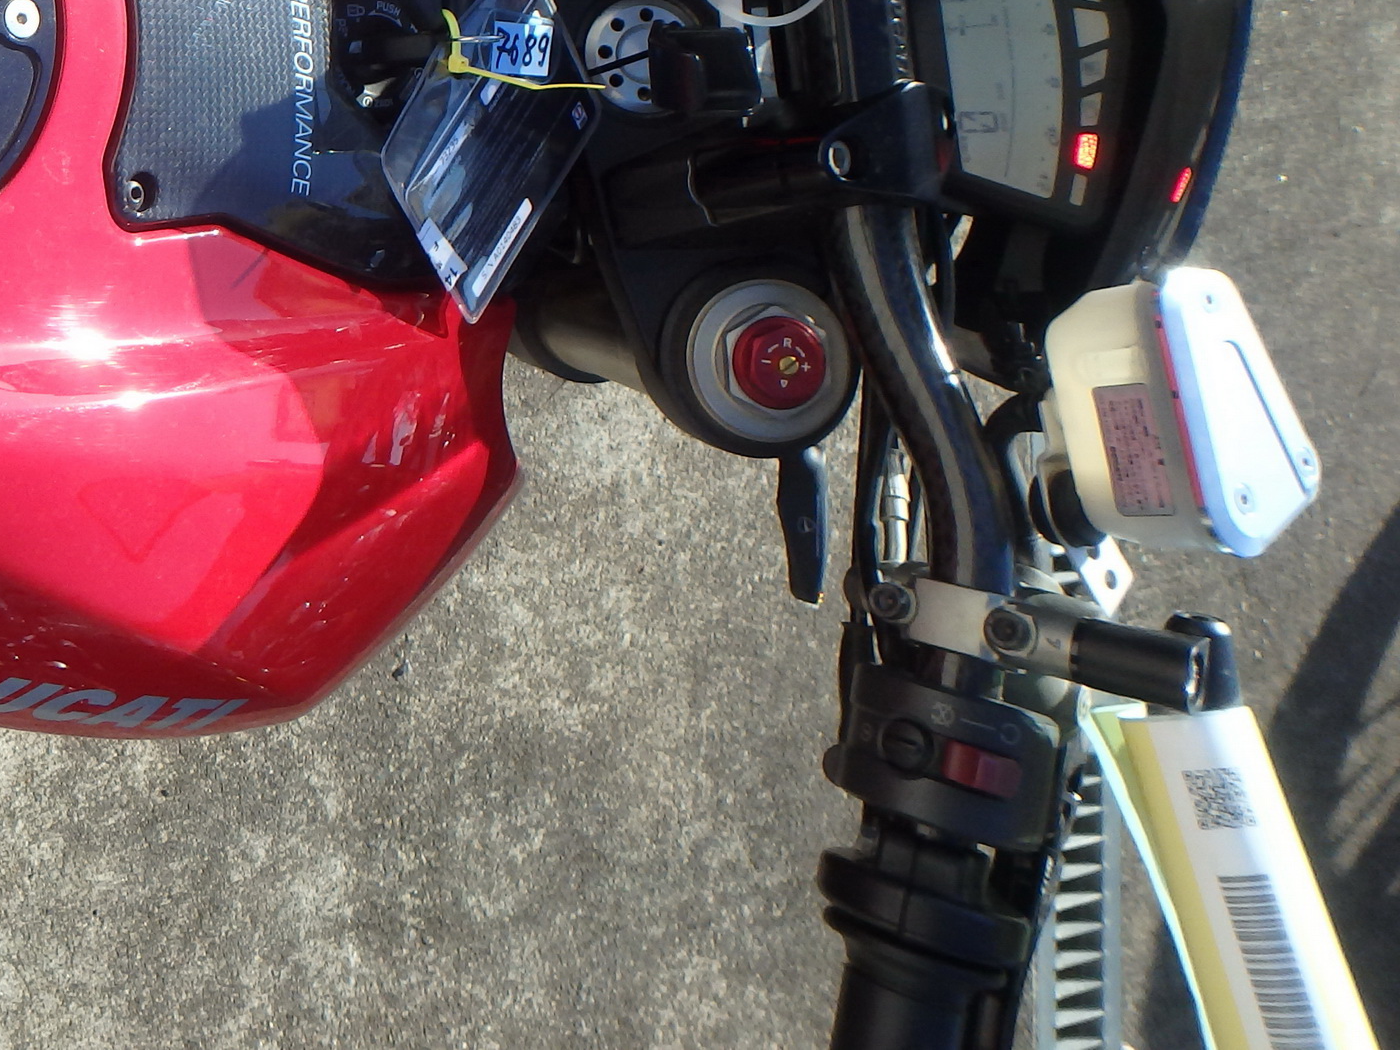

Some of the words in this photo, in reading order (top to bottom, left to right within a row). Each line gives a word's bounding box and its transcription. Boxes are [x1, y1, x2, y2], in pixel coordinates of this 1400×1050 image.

[376, 0, 401, 17] PUSH
[496, 27, 549, 69] 7689
[783, 337, 792, 348] R
